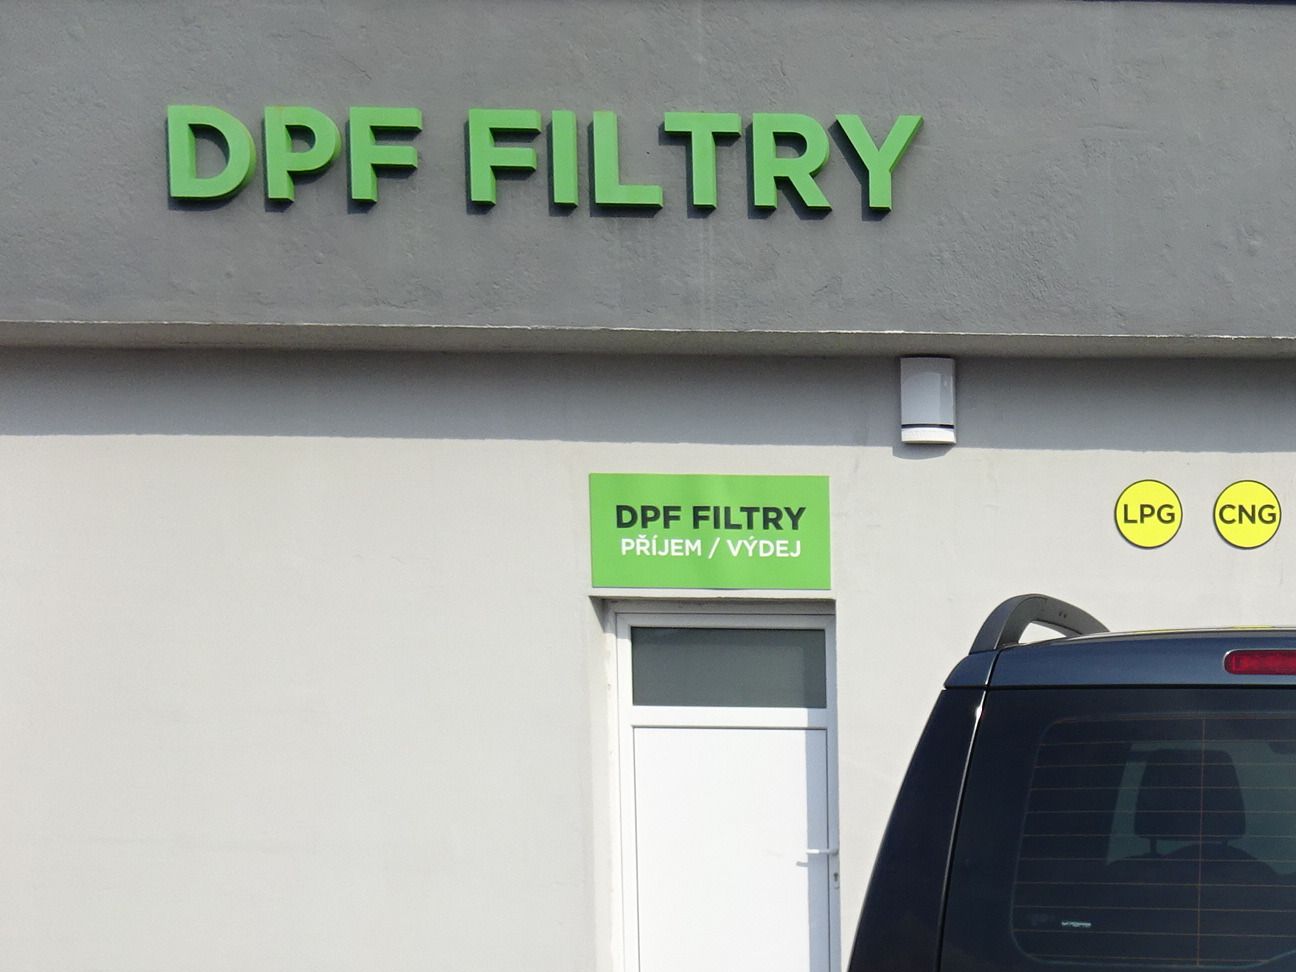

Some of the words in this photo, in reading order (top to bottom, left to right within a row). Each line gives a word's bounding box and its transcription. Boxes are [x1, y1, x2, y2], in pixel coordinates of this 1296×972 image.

[166, 104, 423, 204] DPF
[467, 109, 924, 213] FILTRY
[615, 504, 682, 529] DPF
[692, 505, 807, 530] FILTRY
[1123, 503, 1176, 524] LPG
[1218, 504, 1277, 525] CNG
[620, 534, 702, 556] PŘÍJEM
[726, 536, 802, 558] VÝDEJ
